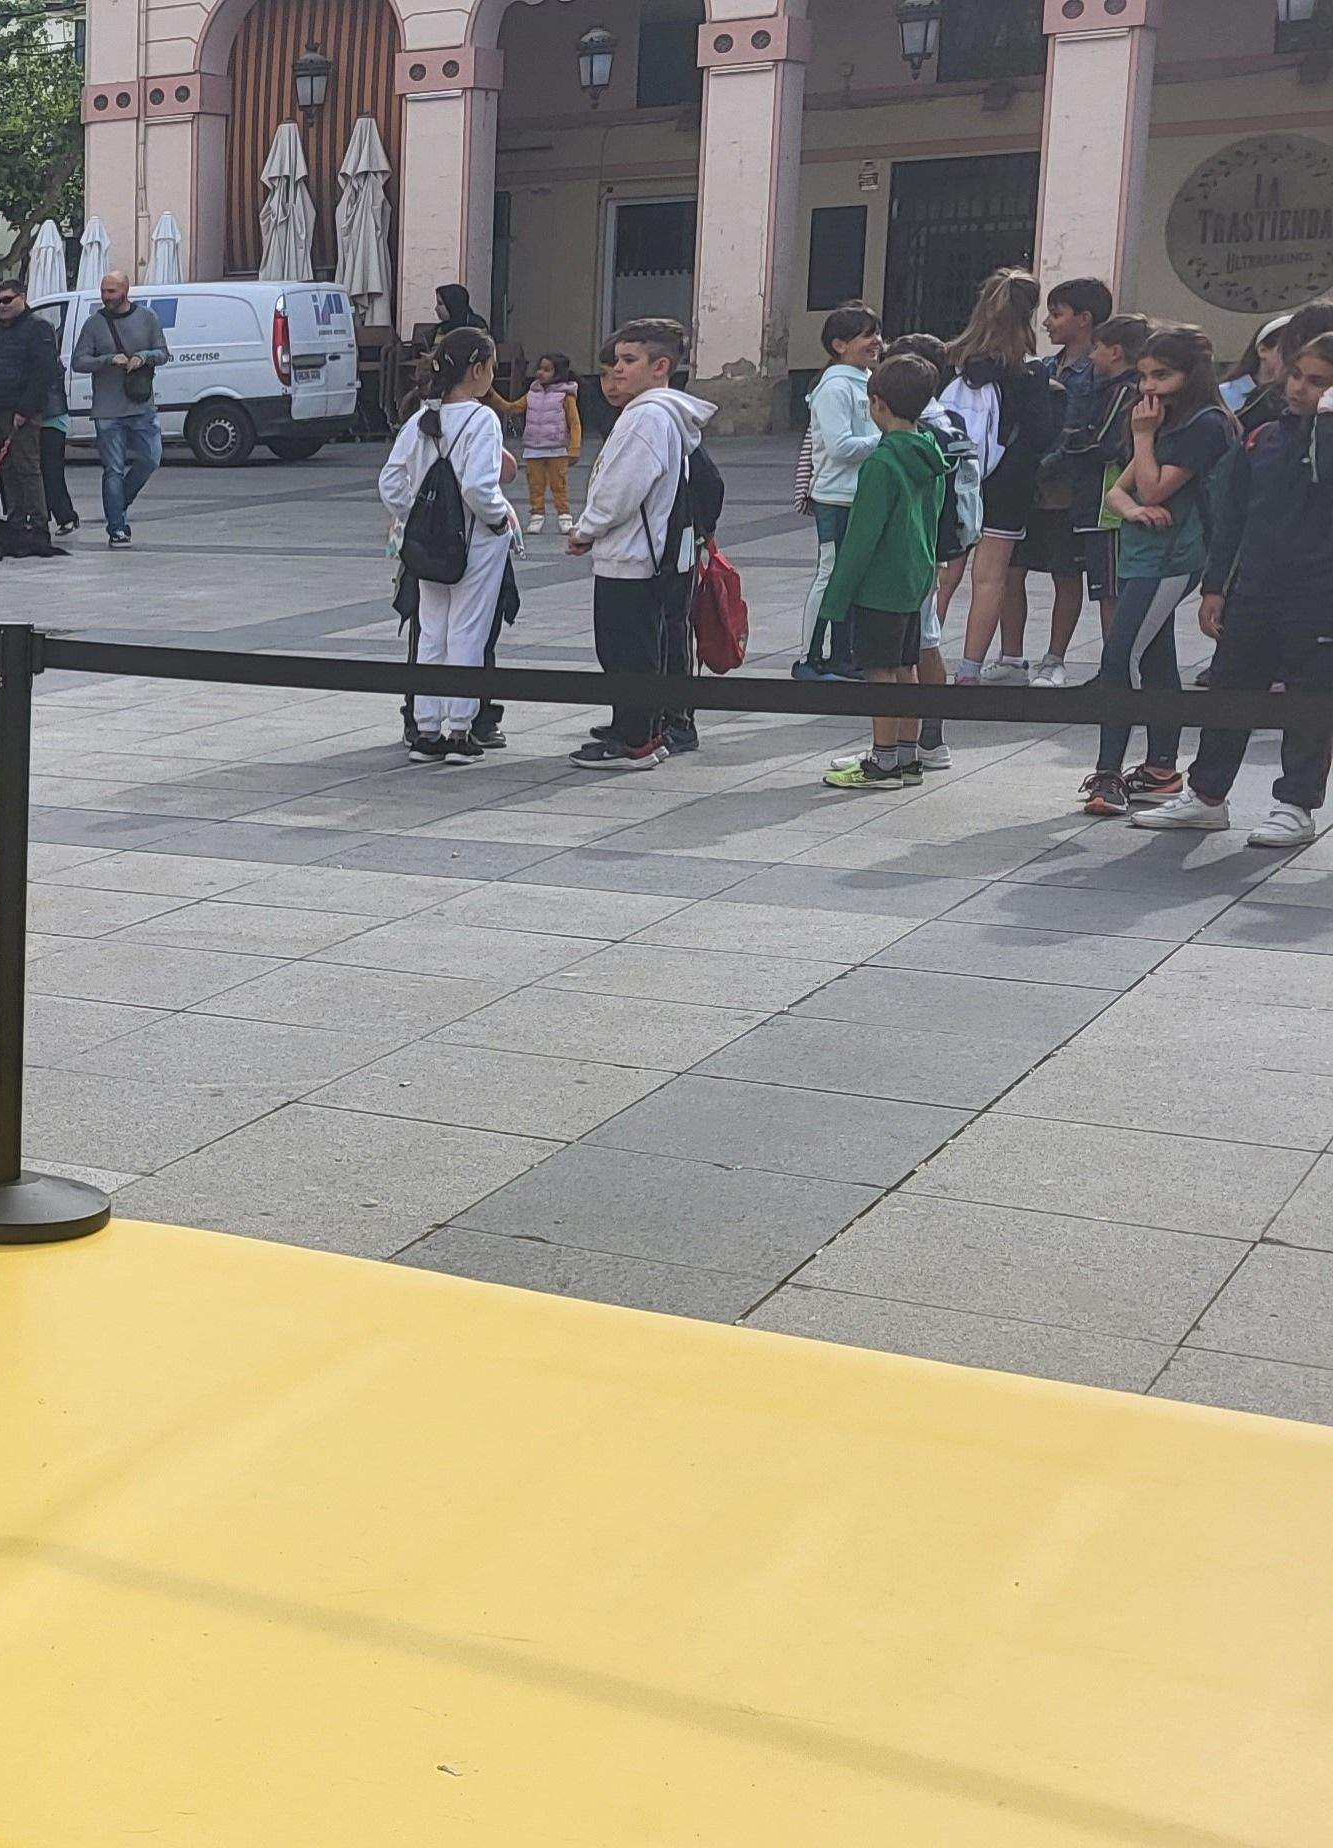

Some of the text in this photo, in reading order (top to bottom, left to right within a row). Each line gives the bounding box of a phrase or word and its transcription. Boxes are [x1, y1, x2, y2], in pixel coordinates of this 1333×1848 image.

[1254, 173, 1281, 208] LA
[1198, 208, 1333, 244] TRASTIENDA
[179, 352, 220, 362] oscense
